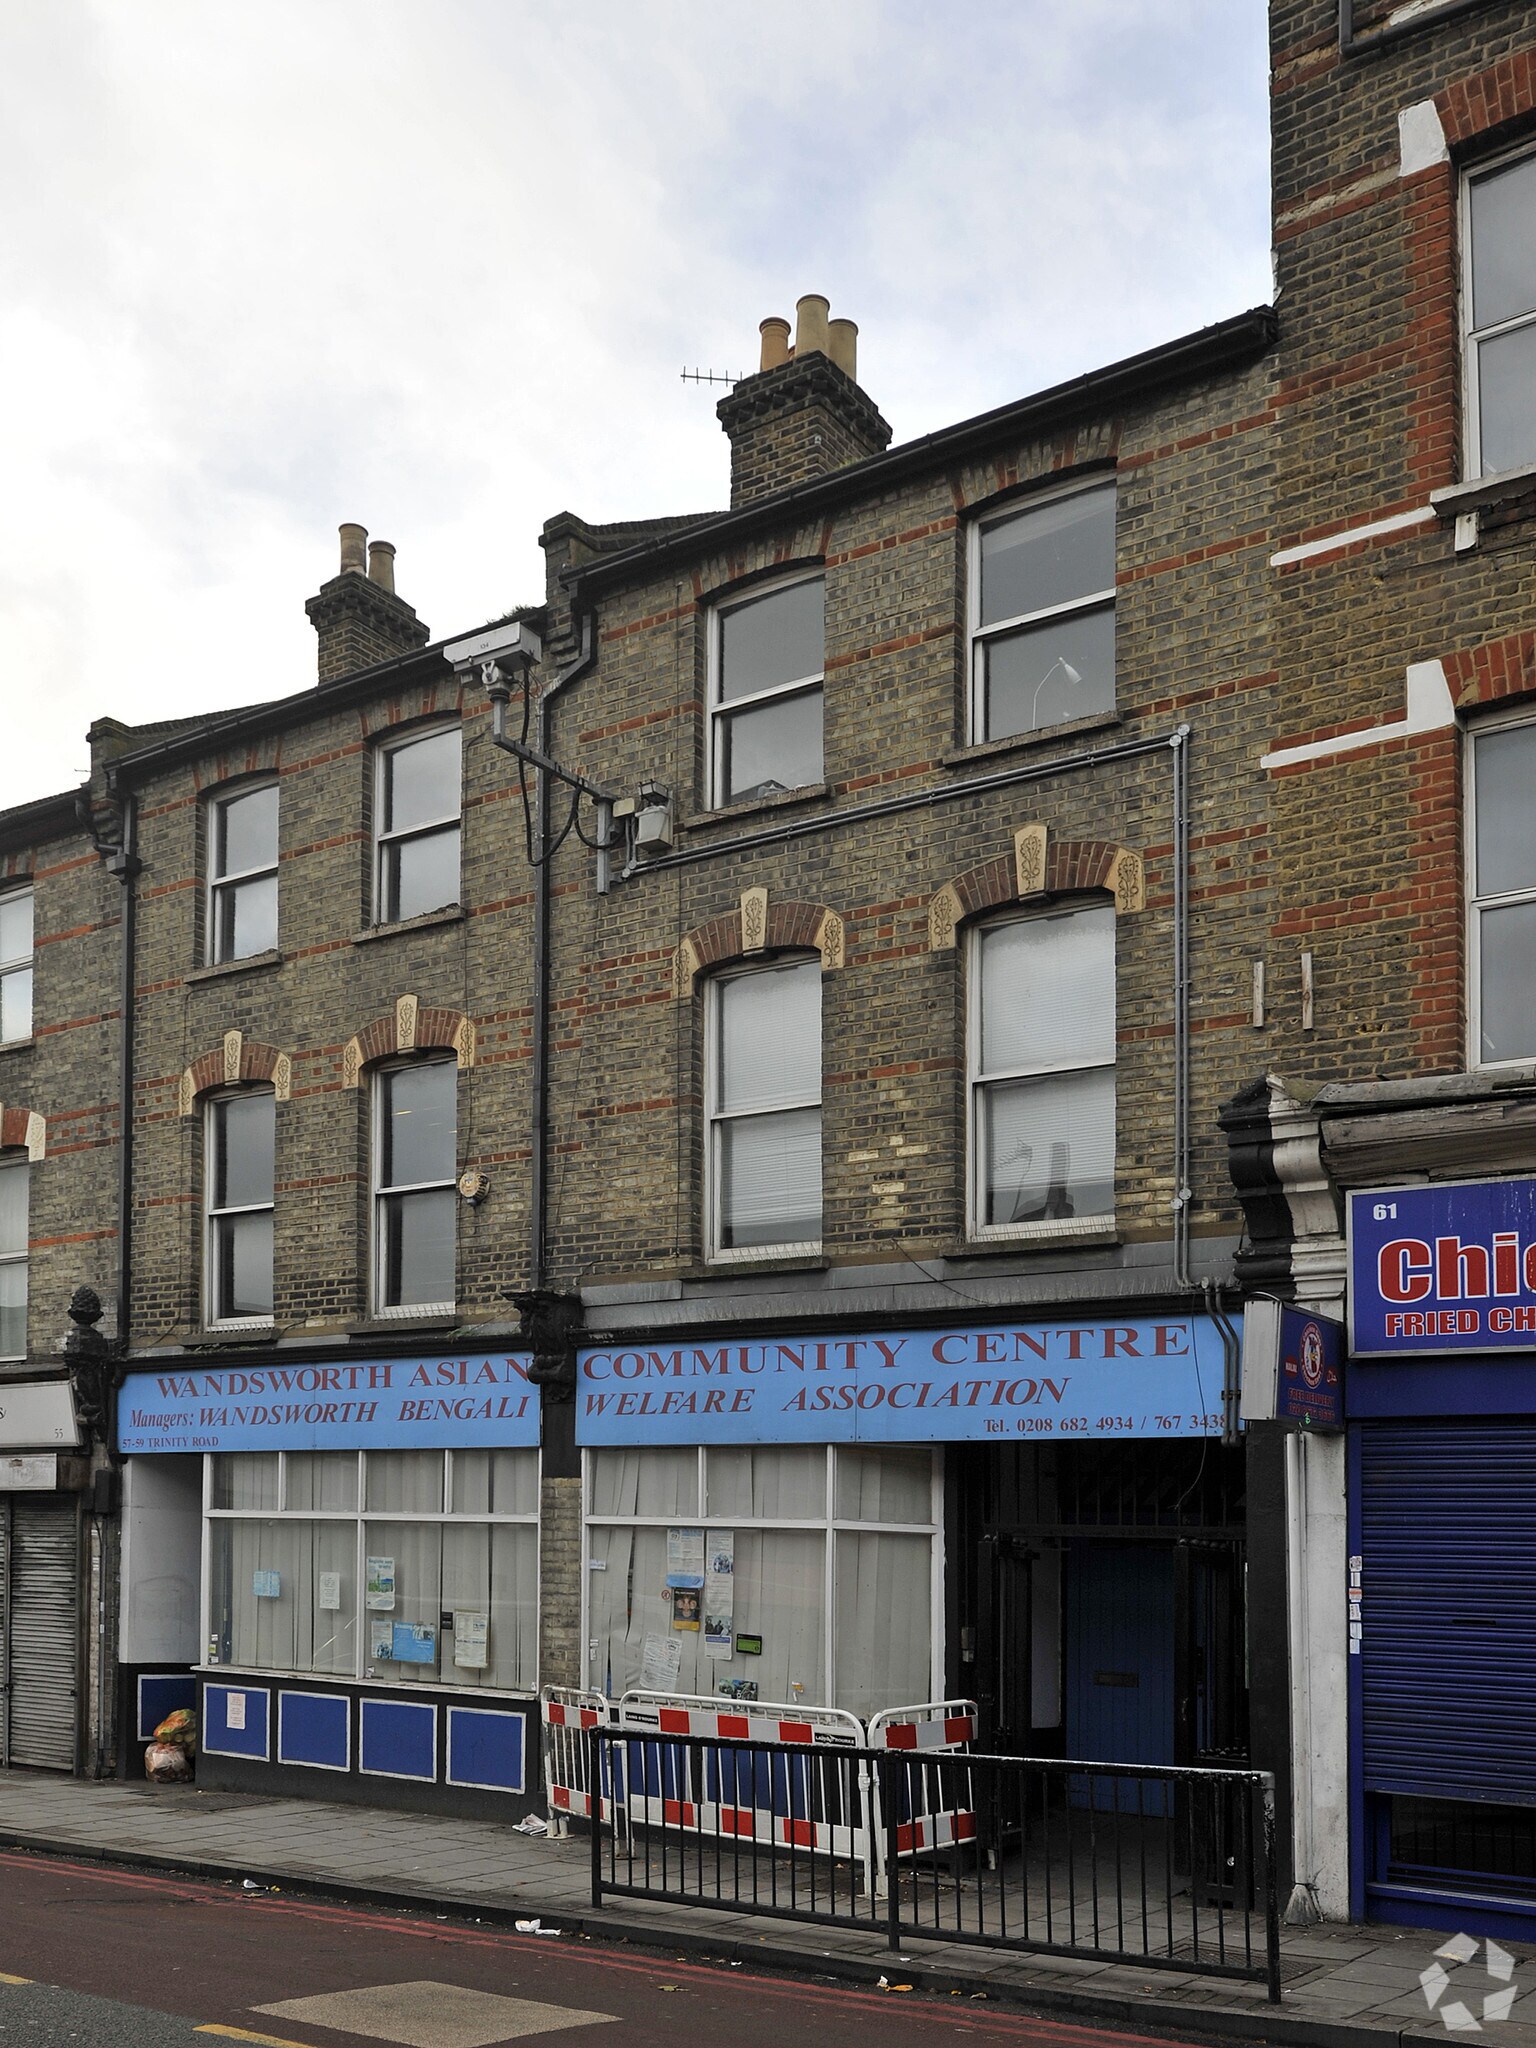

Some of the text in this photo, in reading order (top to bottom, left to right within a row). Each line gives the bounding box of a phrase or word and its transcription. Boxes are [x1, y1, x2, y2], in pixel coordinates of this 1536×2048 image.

[1373, 1203, 1398, 1221] 61
[1385, 1310, 1480, 1338] FRIED
[583, 1324, 1190, 1380] COMMUNITY CENTRE
[157, 1357, 532, 1398] WANDSWORTH ASIAN
[585, 1377, 1072, 1416] WELFARE ASSOCIATION
[129, 1396, 530, 1432] Managers: WANDSWORTH BENGALI
[984, 1419, 1009, 1433] Tel.
[1016, 1418, 1053, 1432] 0208
[1060, 1417, 1088, 1431] 682
[1096, 1416, 1133, 1430] 4934
[1154, 1415, 1182, 1429] 767
[54, 1428, 63, 1439] 55
[122, 1436, 219, 1449] 57-59 TRINITY ROAD
